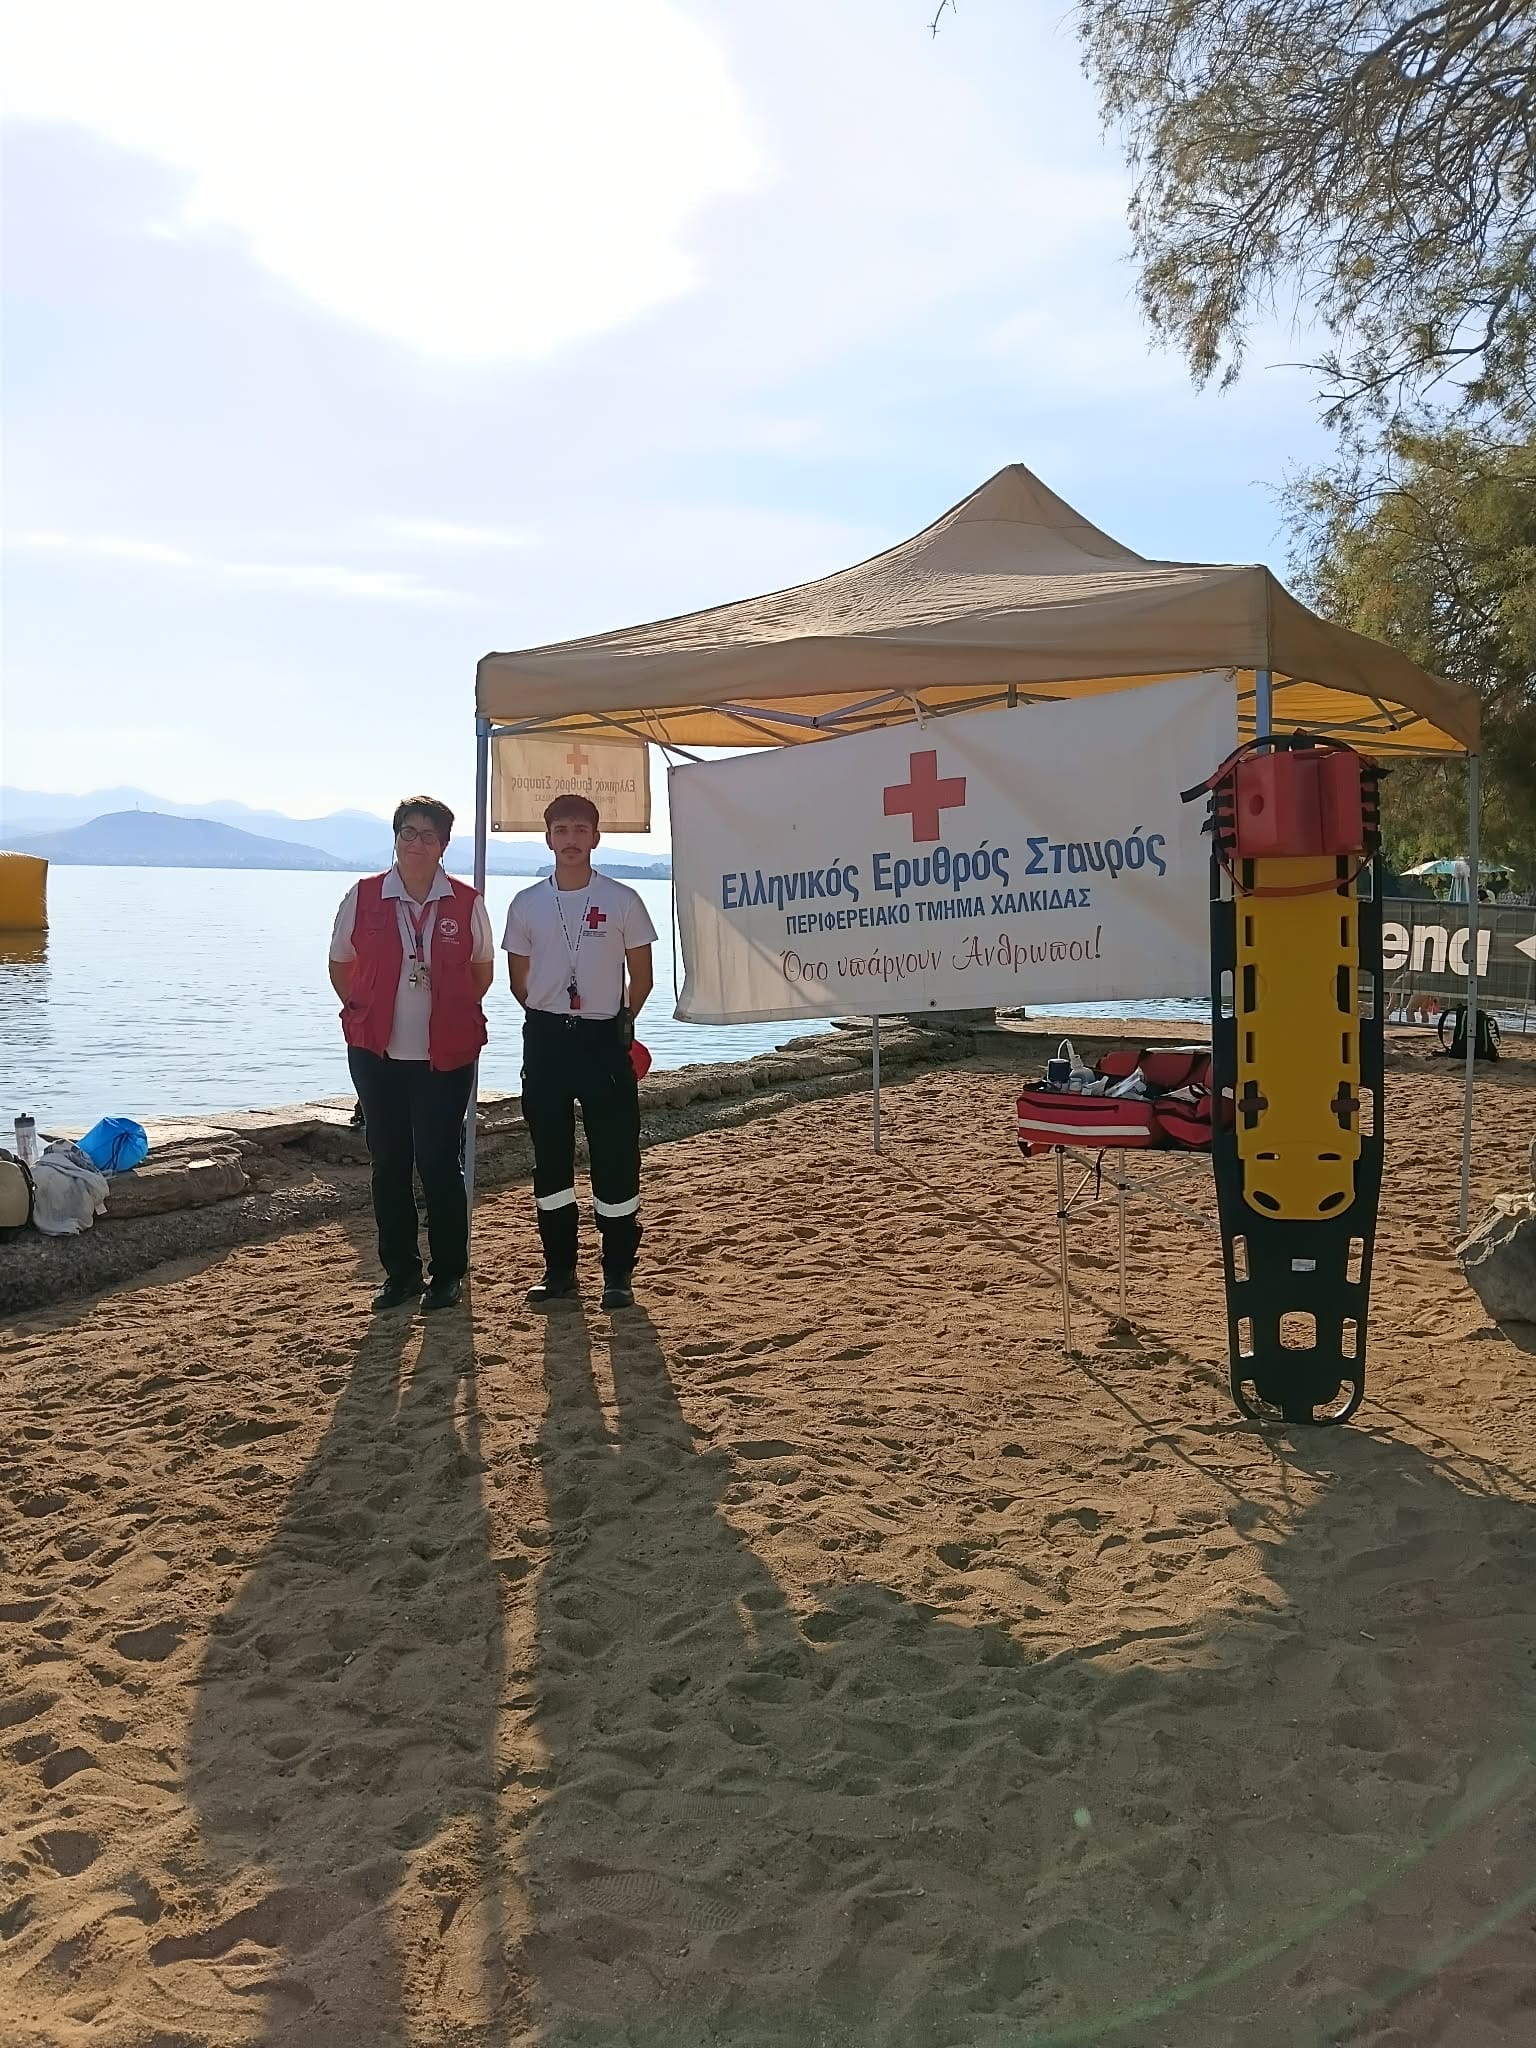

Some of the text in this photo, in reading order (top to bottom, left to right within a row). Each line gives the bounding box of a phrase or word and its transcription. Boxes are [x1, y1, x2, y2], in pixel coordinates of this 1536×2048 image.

[722, 825, 1167, 911] Ελληνικός Ερυθρός Σταυρός
[786, 888, 1091, 935] ΠΕΡΙΦΕΡΕΙΑΚΟ ΤΜΗΜΑ ΧΑΛΚΙΔΑΣ
[779, 925, 1102, 983] Όσο υπάρχουν Άνθρωποι!
